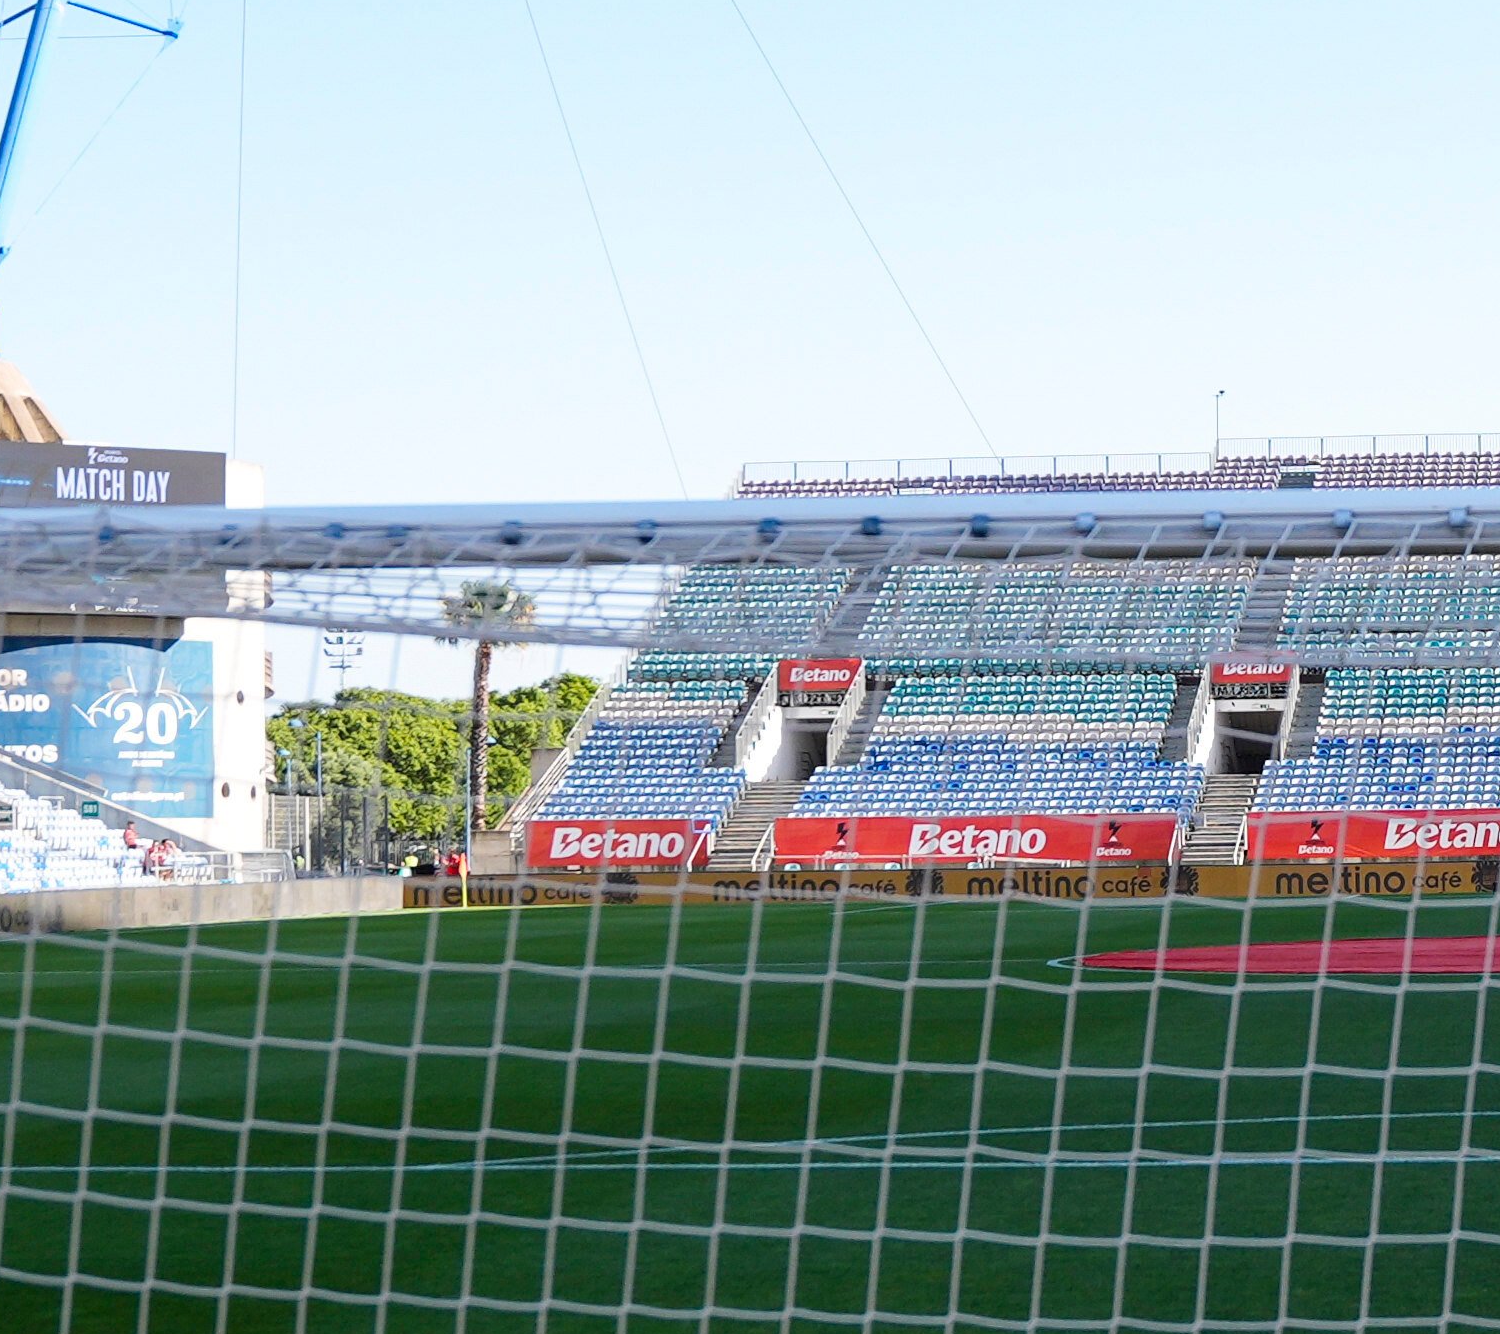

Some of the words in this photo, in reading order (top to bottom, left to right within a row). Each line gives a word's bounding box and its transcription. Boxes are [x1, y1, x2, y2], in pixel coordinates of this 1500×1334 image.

[56, 466, 125, 502] MATCH
[133, 470, 170, 504] DAY
[790, 667, 851, 683] Betano
[112, 701, 178, 745] 20
[550, 827, 684, 859] Betano
[908, 823, 1047, 855] Betano
[1095, 846, 1132, 857] Betano
[1297, 845, 1334, 855] Betano
[967, 870, 1094, 898] meltino
[1102, 875, 1151, 897] café
[1412, 871, 1462, 892] café
